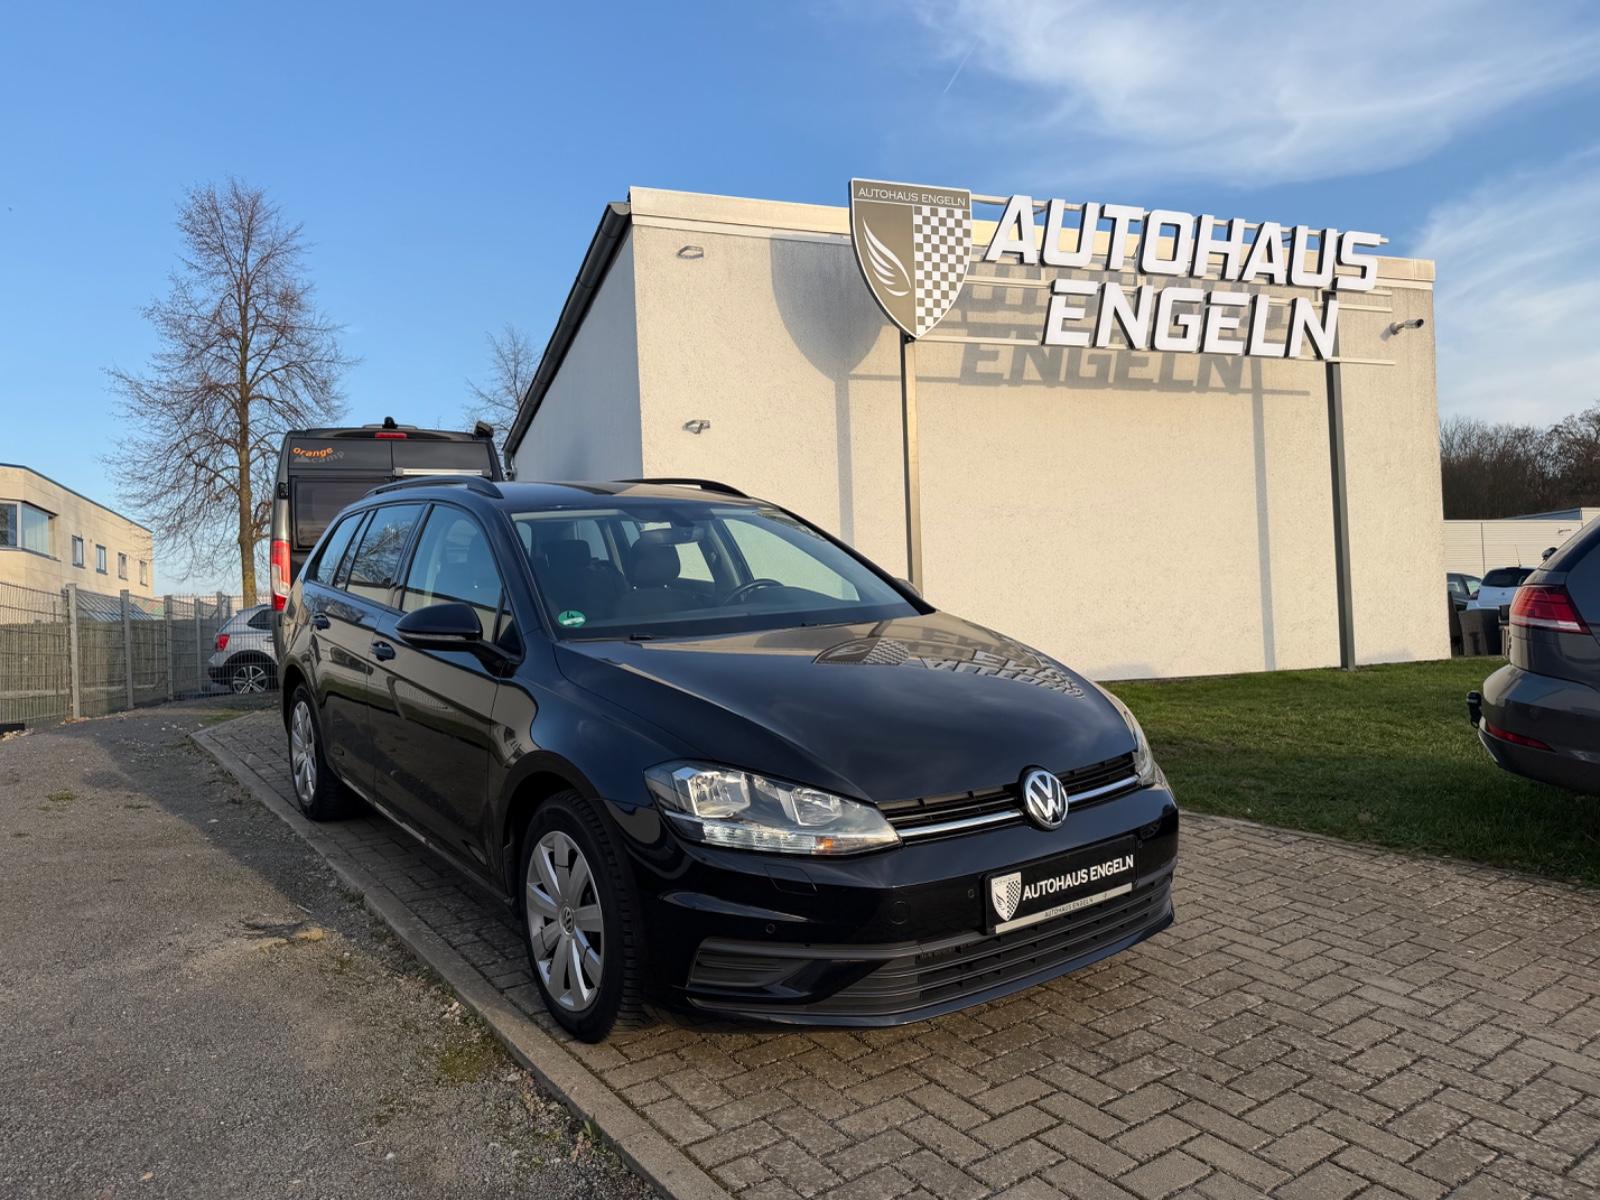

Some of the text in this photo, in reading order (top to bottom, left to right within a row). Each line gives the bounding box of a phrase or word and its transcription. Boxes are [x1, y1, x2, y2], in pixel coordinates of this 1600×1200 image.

[859, 187, 966, 207] AUTOHAUS ENGELN
[985, 194, 1379, 292] AUTOHAUS
[1042, 278, 1339, 360] ENGELN
[1022, 854, 1134, 901] AUTOHAUS ENGELN
